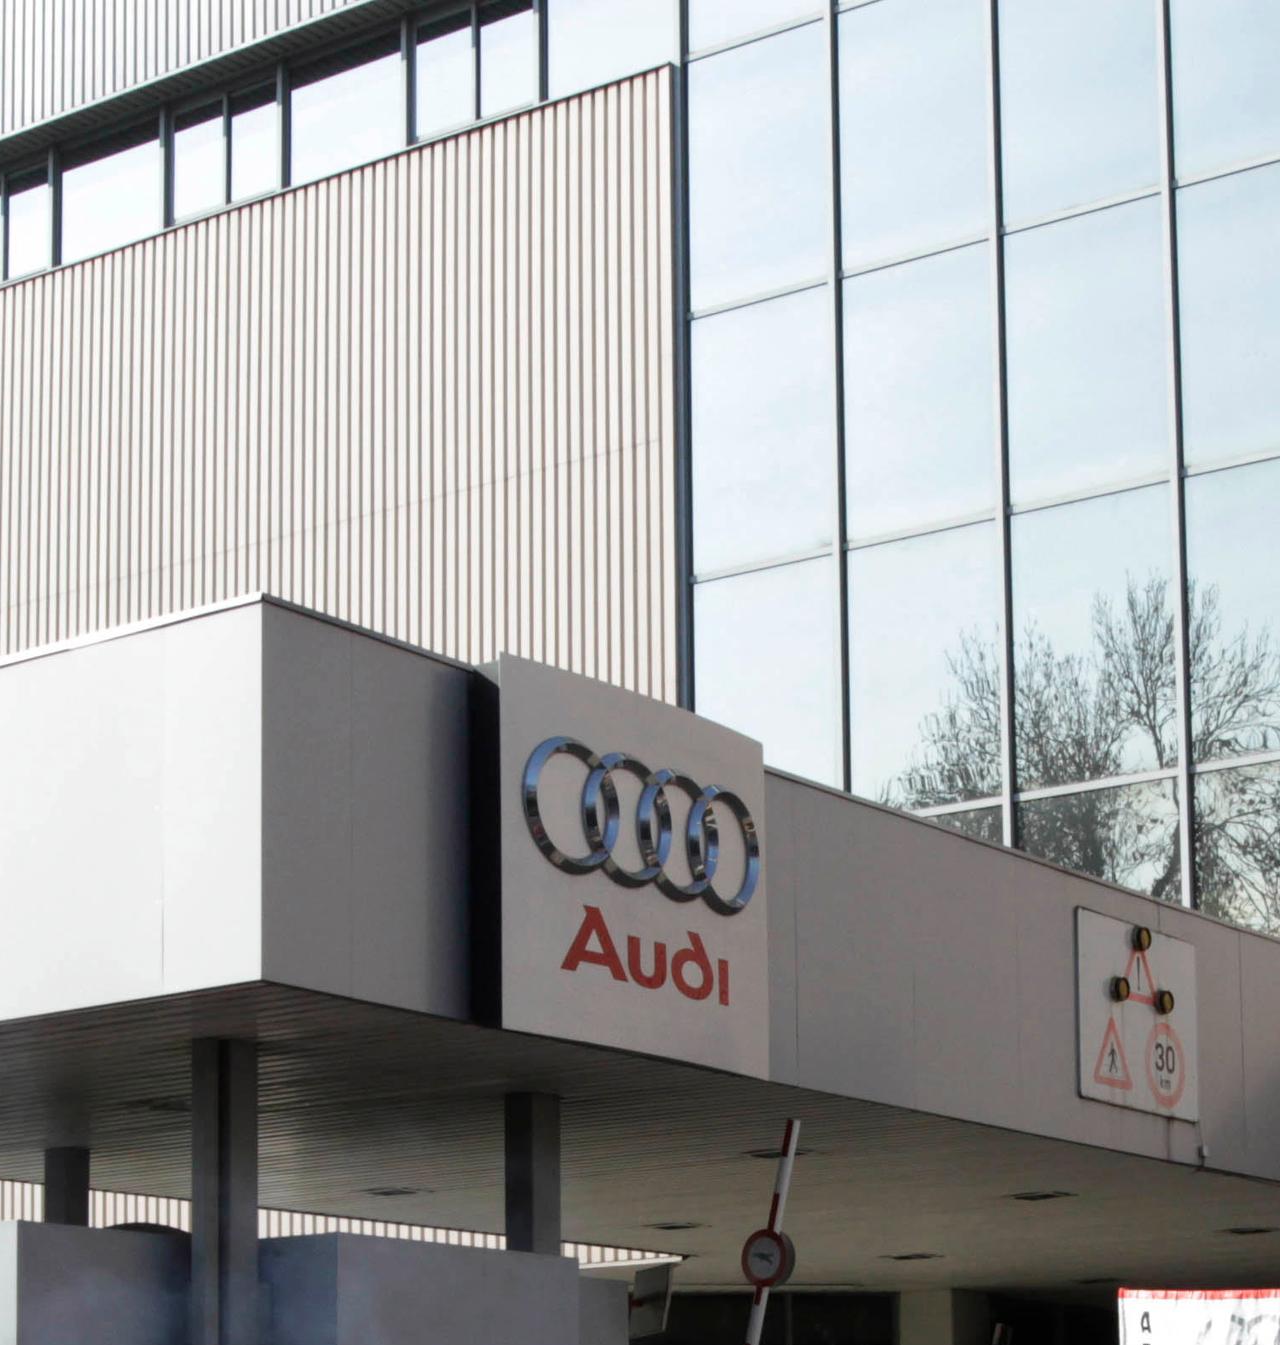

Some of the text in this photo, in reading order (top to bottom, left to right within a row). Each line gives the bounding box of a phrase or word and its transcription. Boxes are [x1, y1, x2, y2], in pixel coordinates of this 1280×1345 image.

[560, 904, 730, 1007] Audi
[1154, 1042, 1176, 1075] 30
[1159, 1077, 1172, 1090] km
